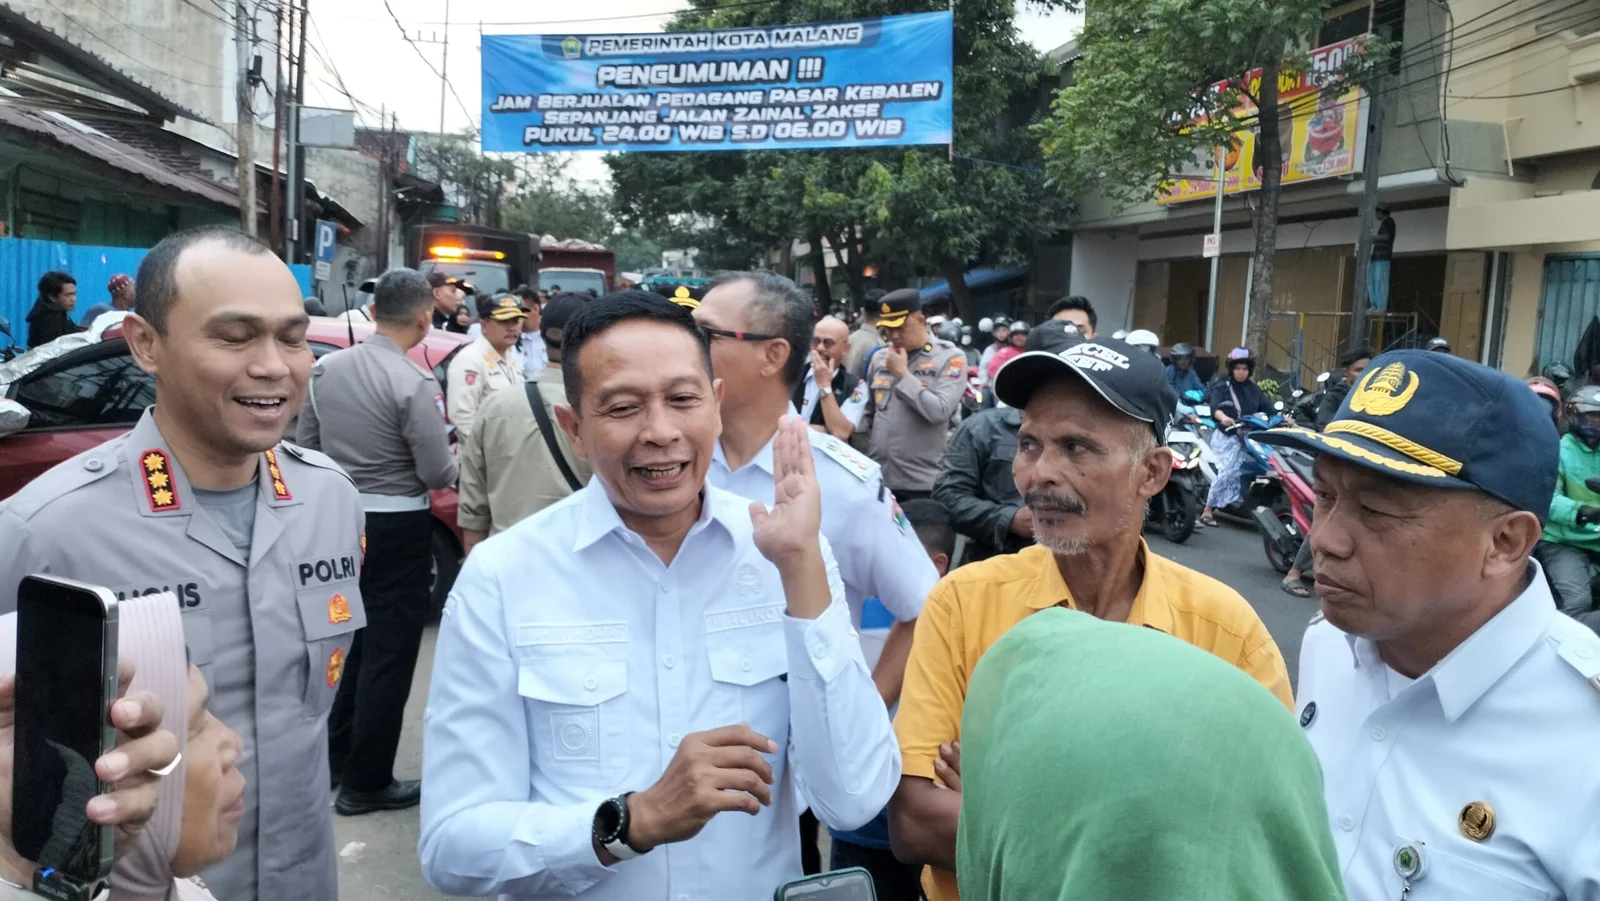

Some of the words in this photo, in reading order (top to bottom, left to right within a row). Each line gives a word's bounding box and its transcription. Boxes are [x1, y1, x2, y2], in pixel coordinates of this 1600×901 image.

[587, 34, 709, 53] PEMERINTAH
[716, 32, 766, 47] KOTA
[773, 26, 861, 45] MALANG
[597, 58, 790, 86] PENGUMUMAN
[797, 57, 823, 79] !!!
[490, 95, 531, 110] JAM
[537, 93, 650, 109] BERJUALAN
[656, 90, 763, 107] PEDAGANG
[769, 87, 838, 104] PASAR
[845, 82, 940, 101] KEBALEN
[543, 110, 657, 125] SEPANJANG
[663, 108, 727, 123] JALAN
[732, 106, 805, 122] ZAINAL
[811, 103, 880, 119] ZAKSE
[524, 126, 595, 143] PUKUL
[602, 124, 671, 141] 24.00
[678, 124, 724, 140] WIB
[730, 123, 768, 140] S.D
[774, 120, 846, 138] 06.00
[854, 119, 902, 136] WIB
[318, 225, 333, 257] P
[298, 555, 356, 586] POLRI
